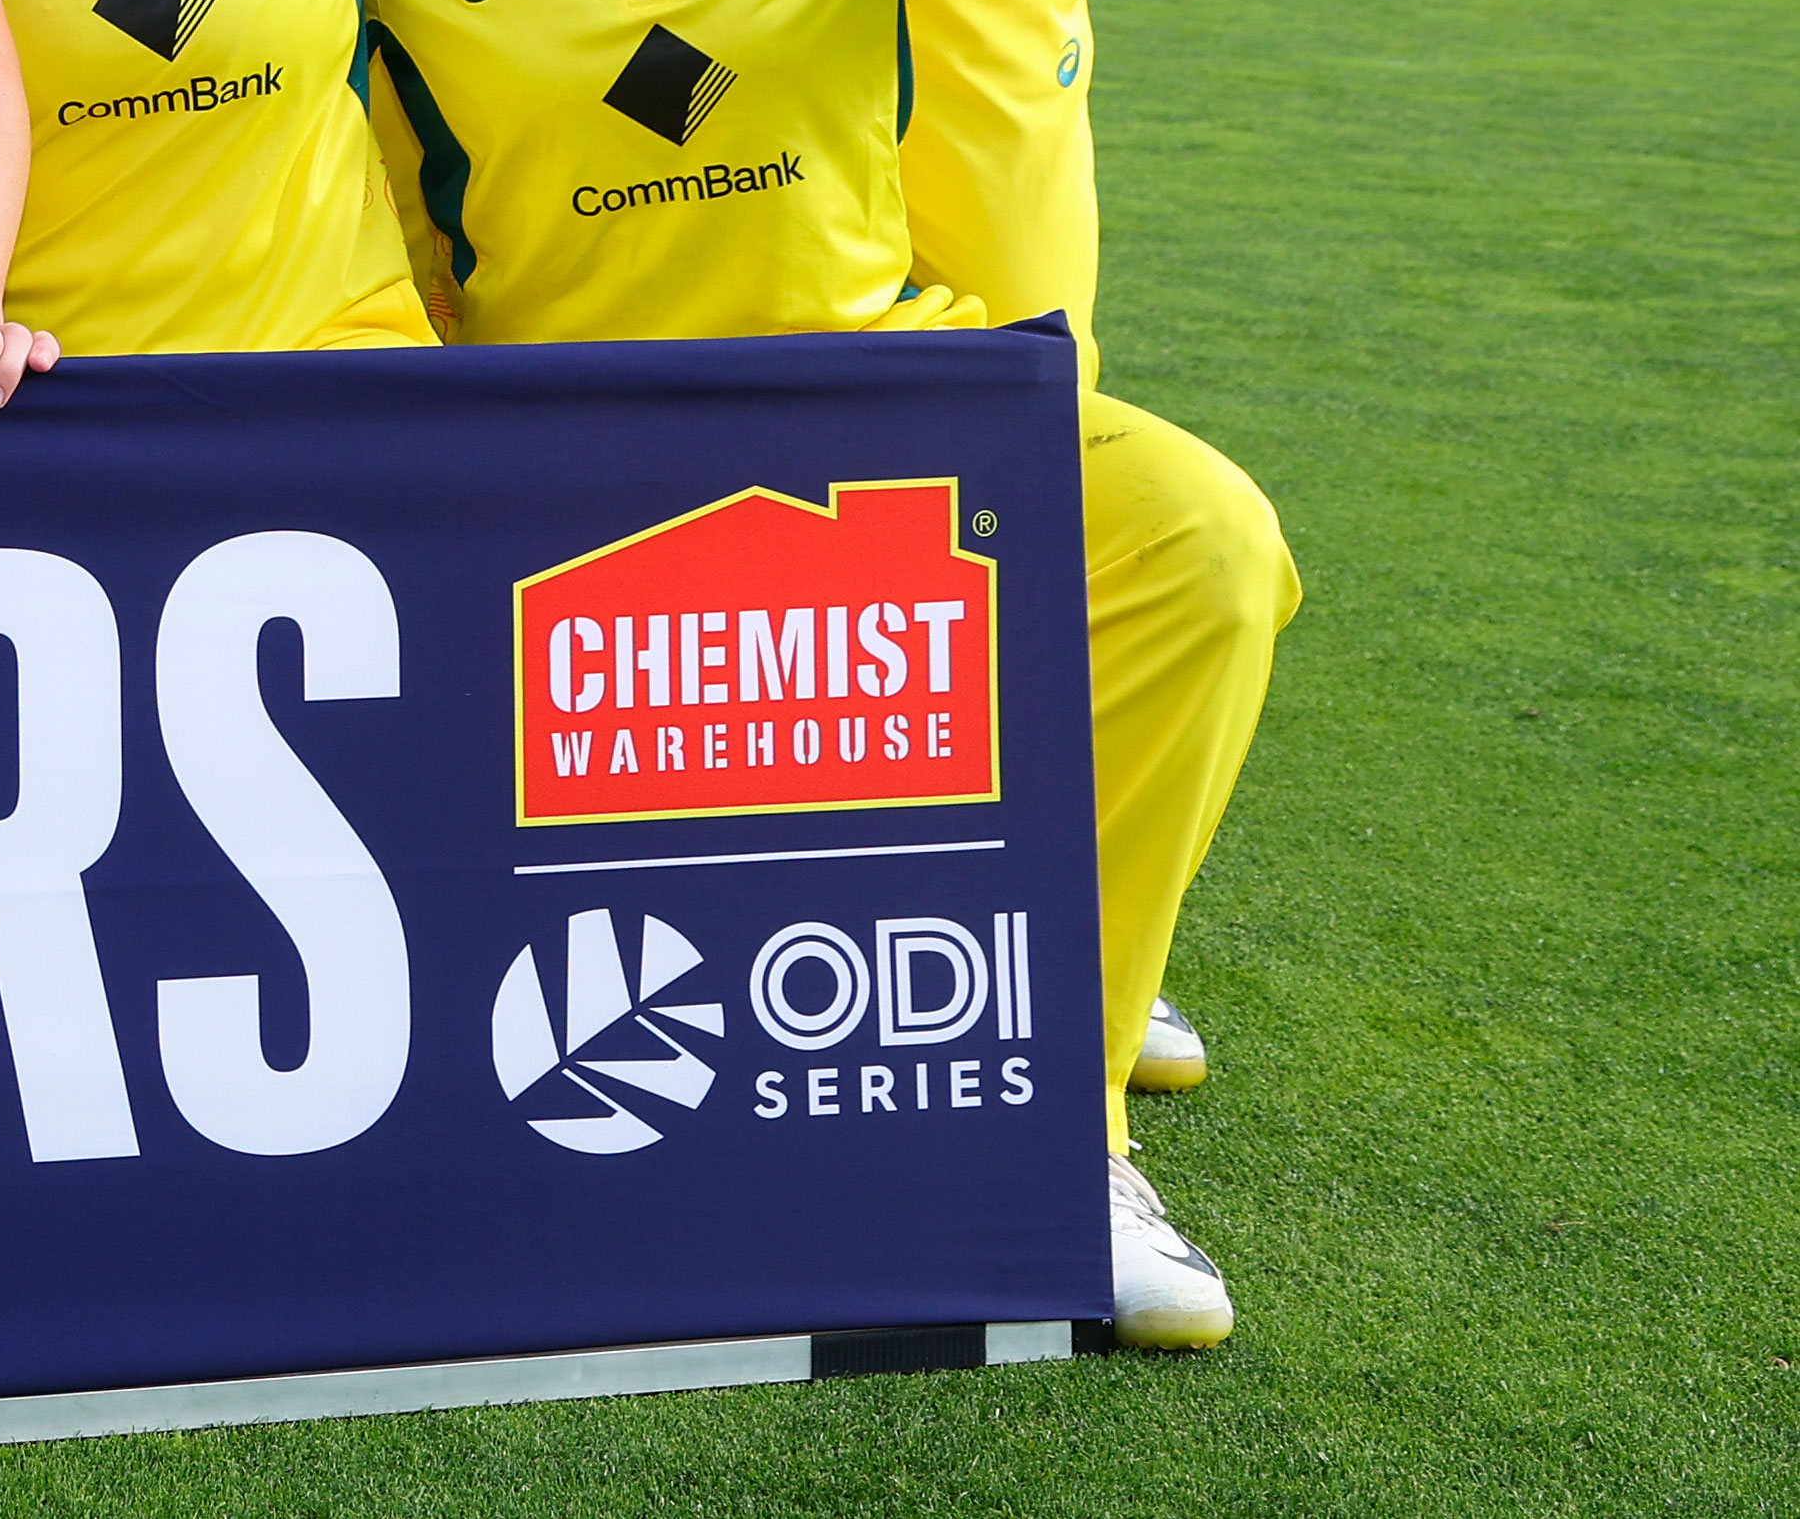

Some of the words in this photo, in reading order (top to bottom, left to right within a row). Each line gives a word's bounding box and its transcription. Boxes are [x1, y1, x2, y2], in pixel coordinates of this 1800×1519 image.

[58, 62, 285, 127] CommBank
[572, 151, 805, 217] CommBank
[549, 600, 964, 714] CHEMIST
[552, 712, 952, 777] WAREHOUSE
[749, 911, 1033, 1051] ODI
[753, 1057, 1035, 1119] SERIES
